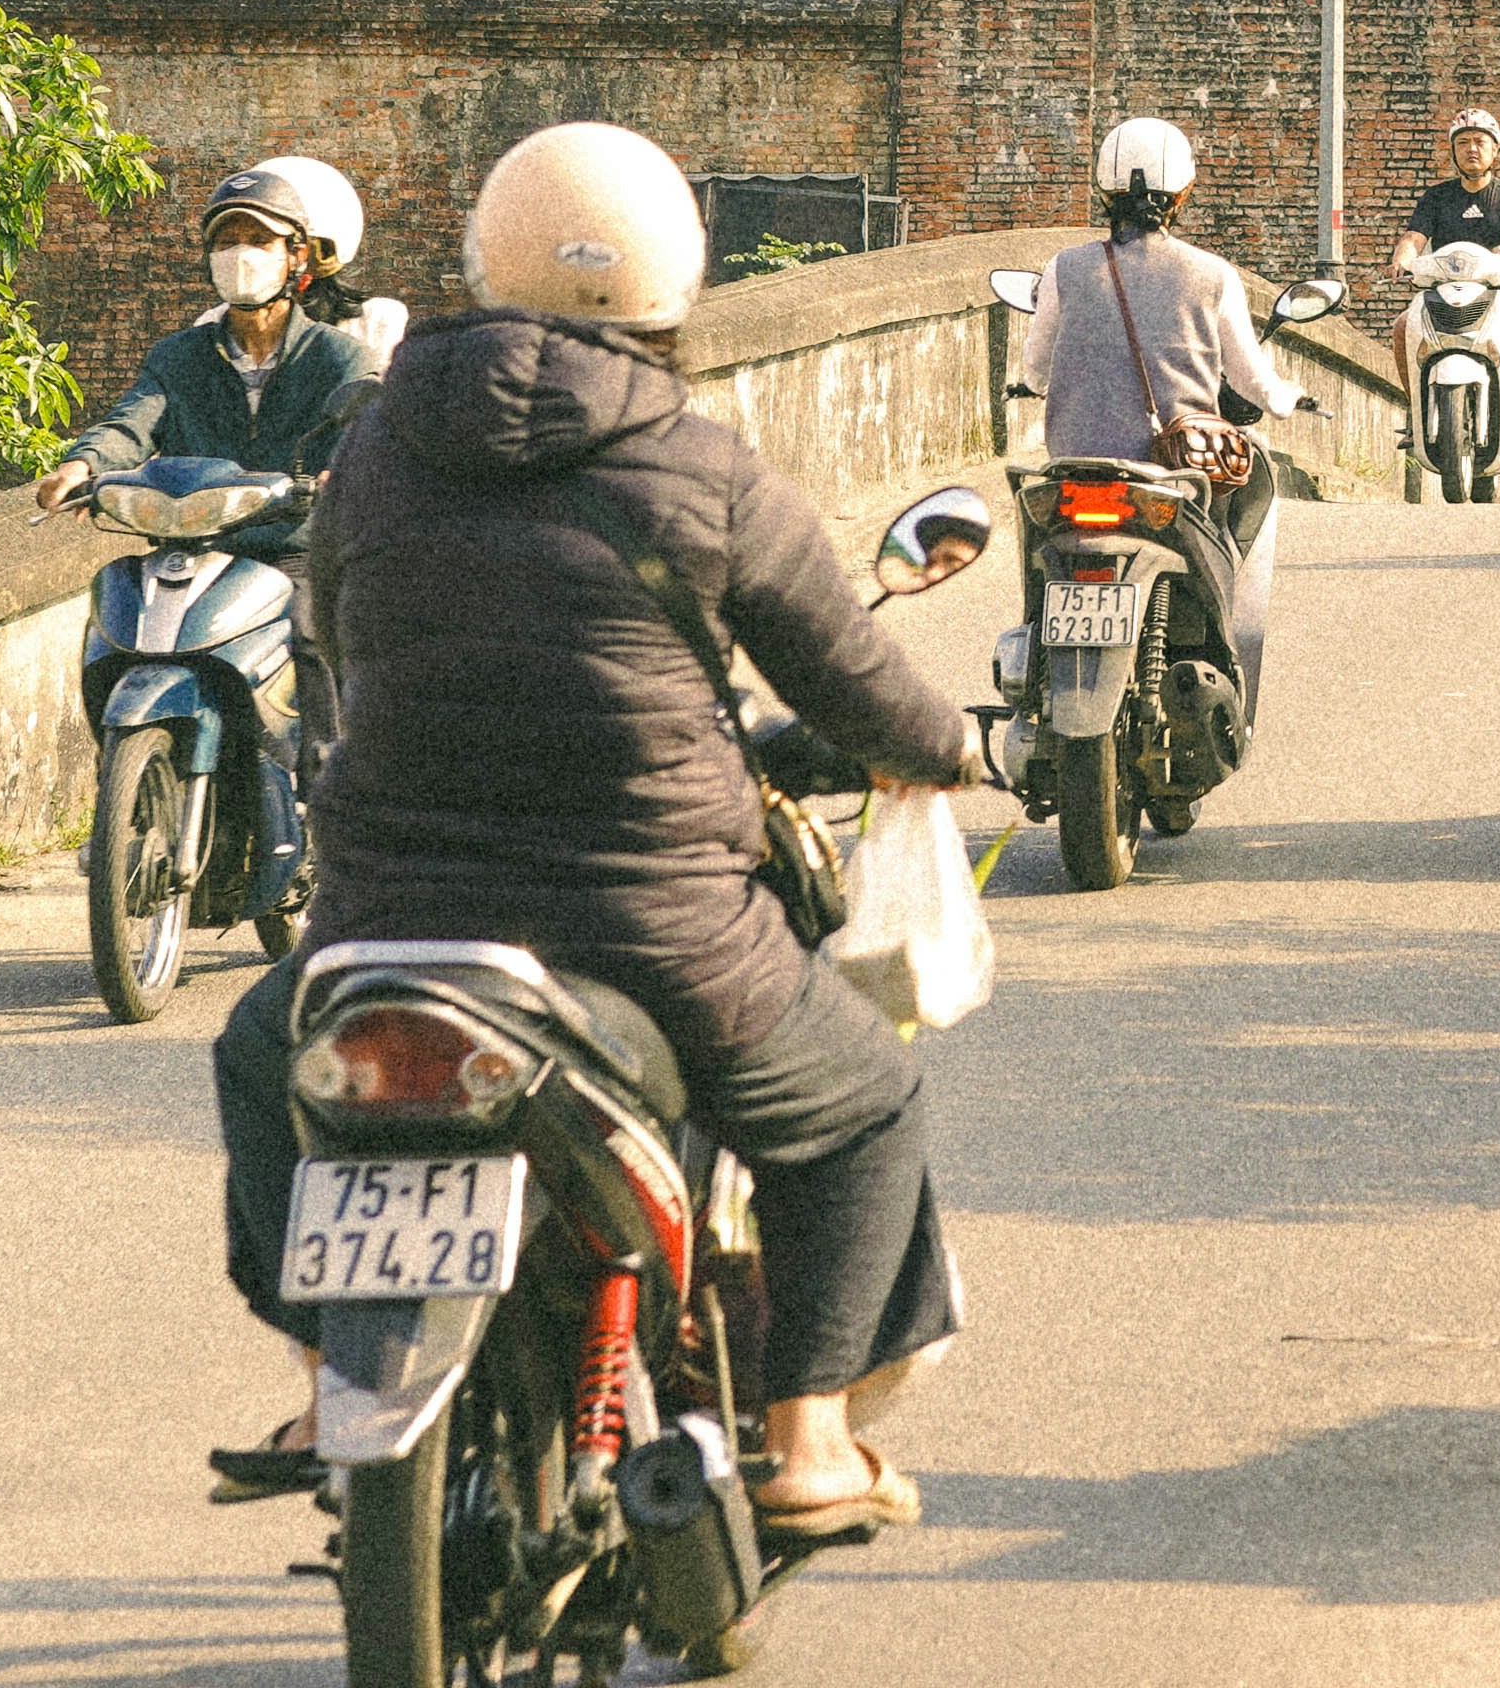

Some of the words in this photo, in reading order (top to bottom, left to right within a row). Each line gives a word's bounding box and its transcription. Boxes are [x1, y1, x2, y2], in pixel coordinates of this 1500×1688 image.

[1060, 586, 1122, 612] 75-F1
[1049, 616, 1128, 643] 623.01
[333, 1162, 480, 1221] 75-F1
[298, 1229, 496, 1287] 374.28
